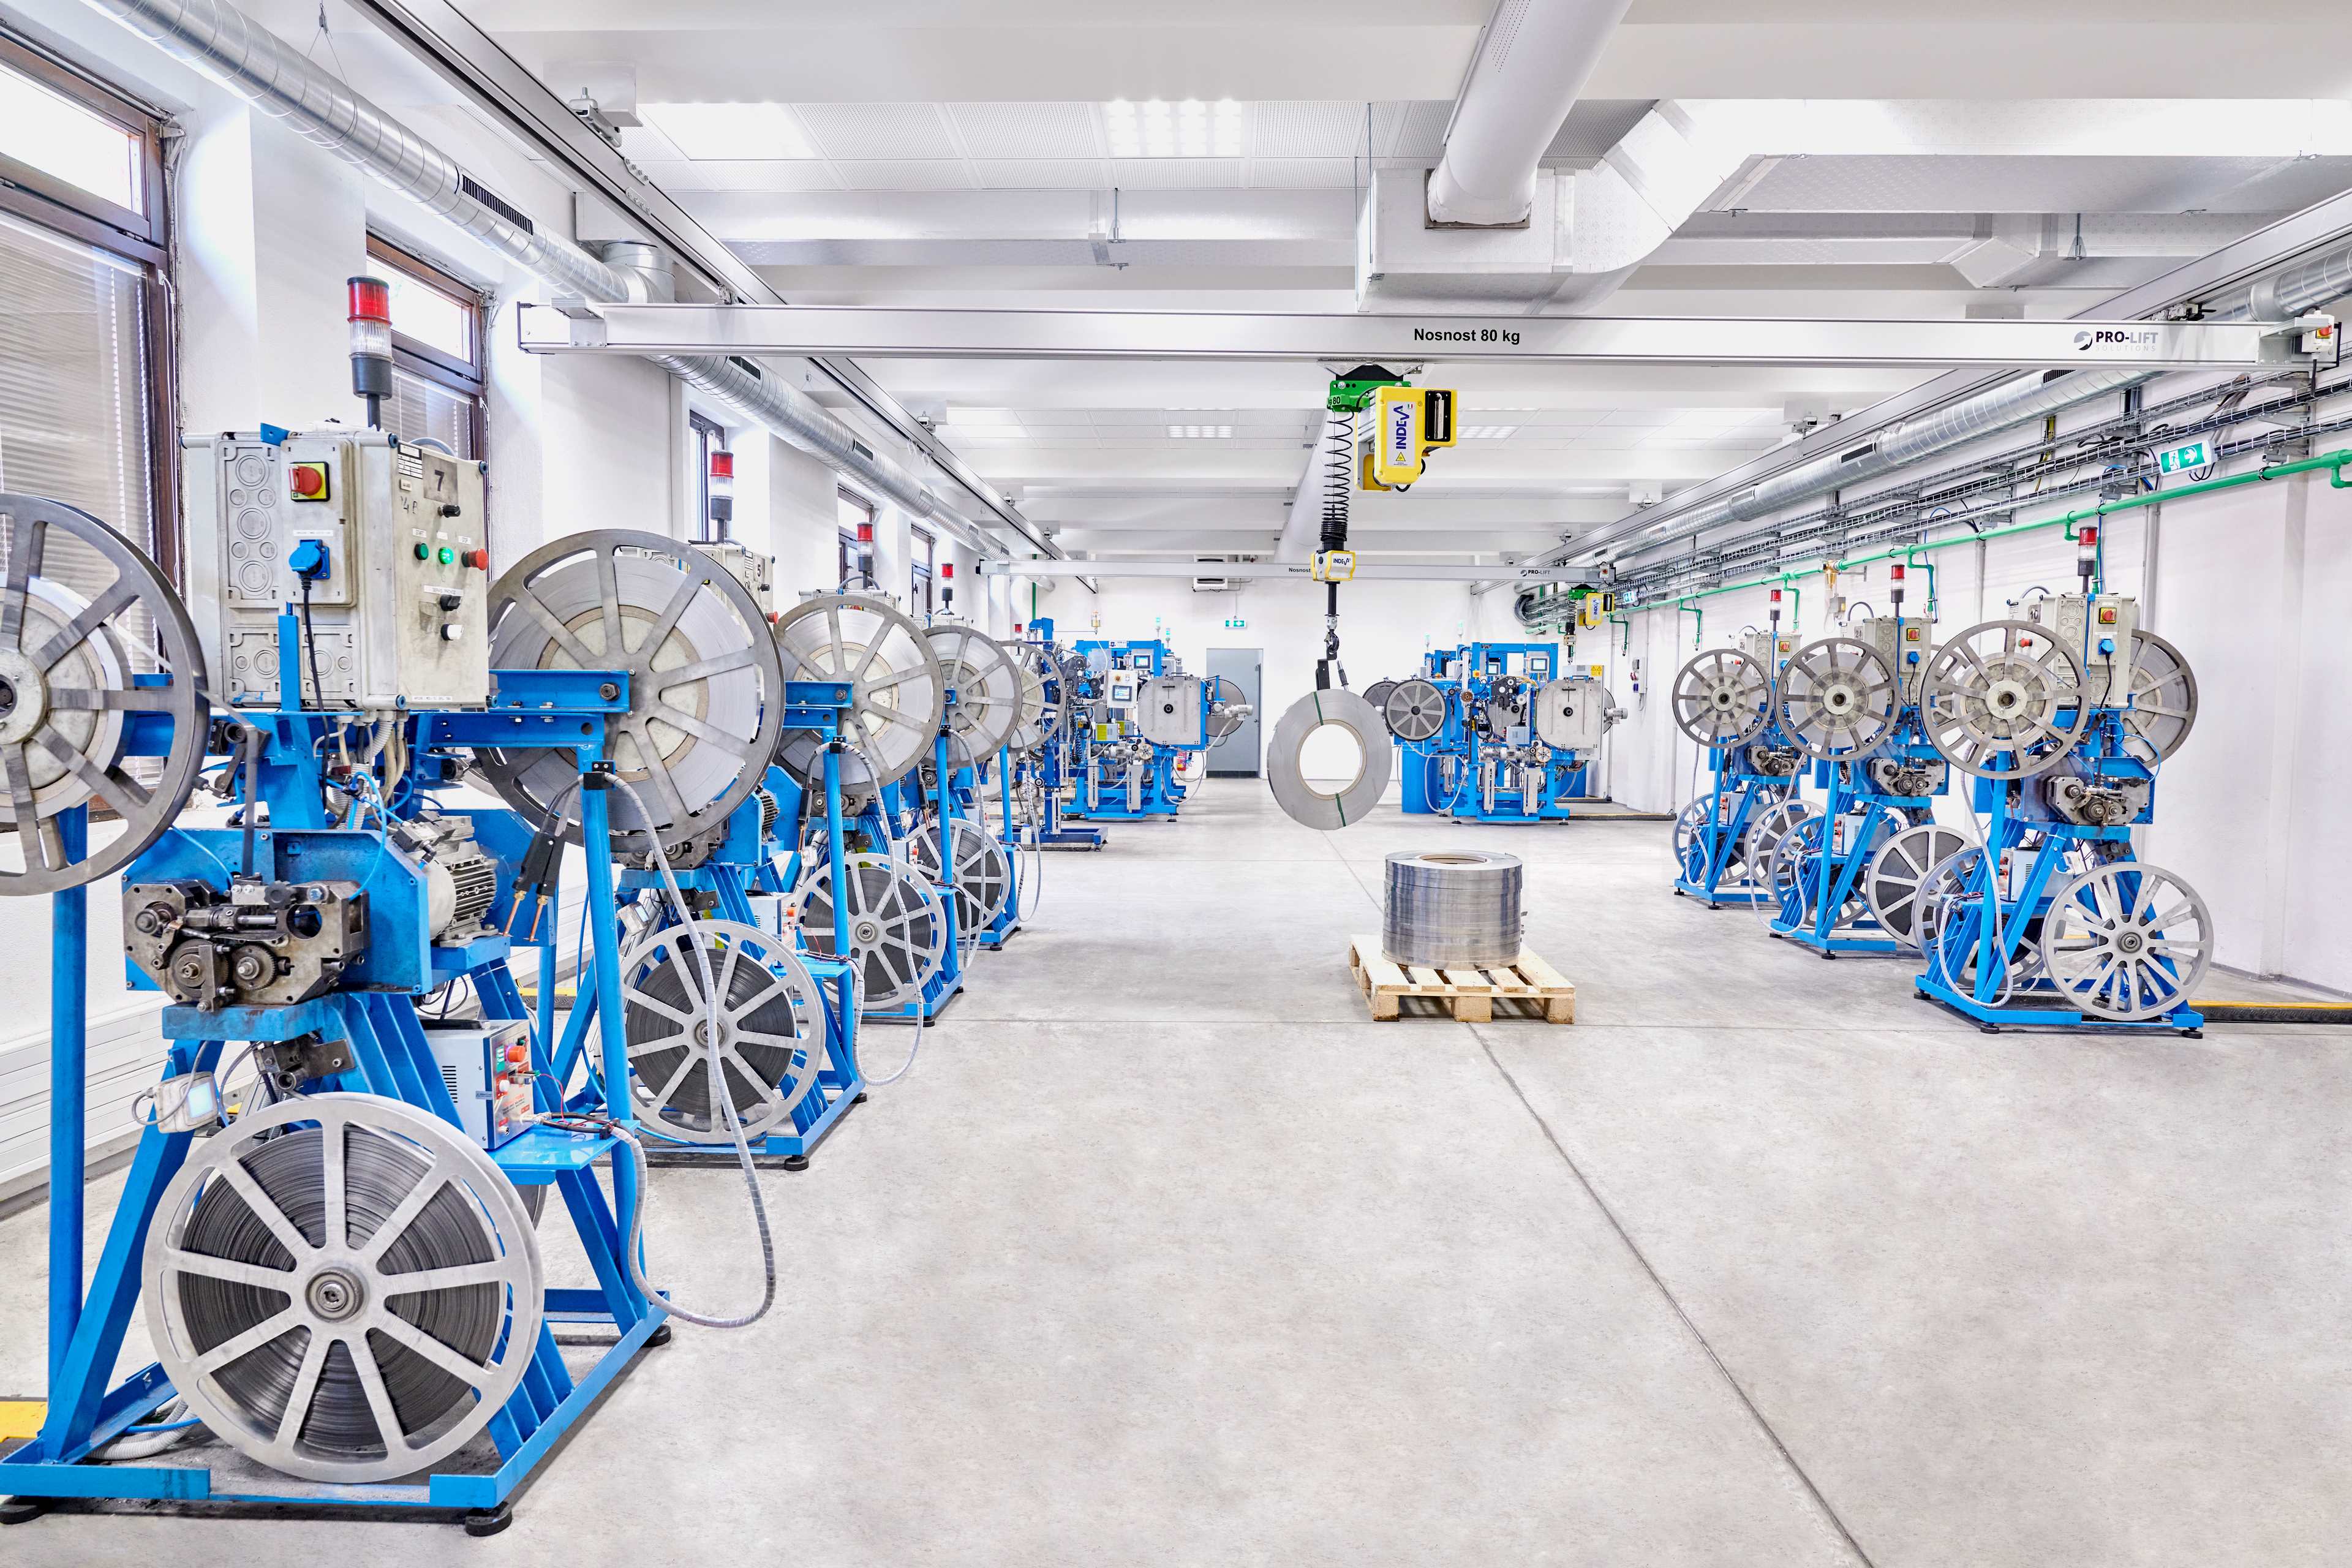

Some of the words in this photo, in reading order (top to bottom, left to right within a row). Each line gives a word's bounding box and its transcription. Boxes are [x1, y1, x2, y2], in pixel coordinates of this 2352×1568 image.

[1414, 328, 1476, 341] Nosnost
[1480, 329, 1498, 342] 80
[1502, 330, 1520, 345] kg
[2095, 331, 2158, 344] PRO-LIFT
[1333, 396, 1341, 405] 80
[1393, 405, 1410, 450] INDEVA
[434, 469, 445, 492] 7
[757, 564, 761, 577] 5
[2030, 609, 2038, 620] 10
